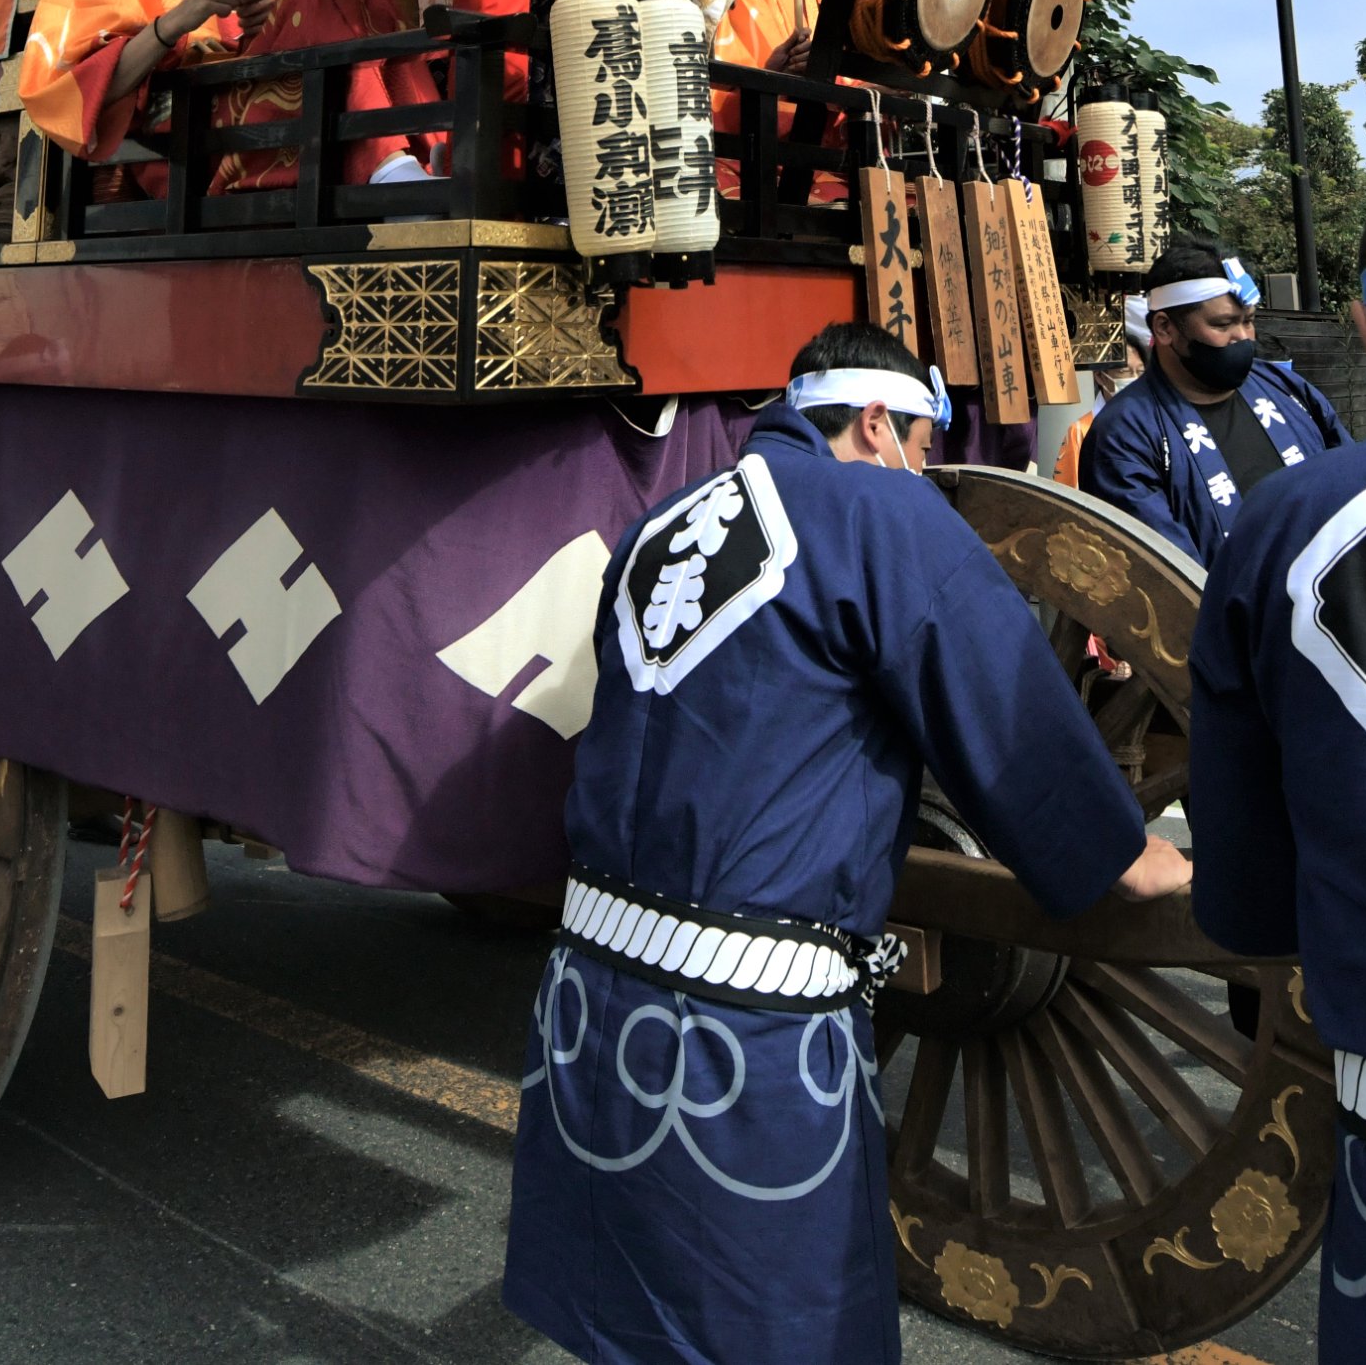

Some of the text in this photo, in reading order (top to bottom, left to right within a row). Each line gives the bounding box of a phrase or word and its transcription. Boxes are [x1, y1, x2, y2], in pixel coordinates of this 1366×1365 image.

[879, 199, 912, 343] 大手
[985, 222, 1019, 406] 鈿女の山車
[641, 478, 745, 649] 大手
